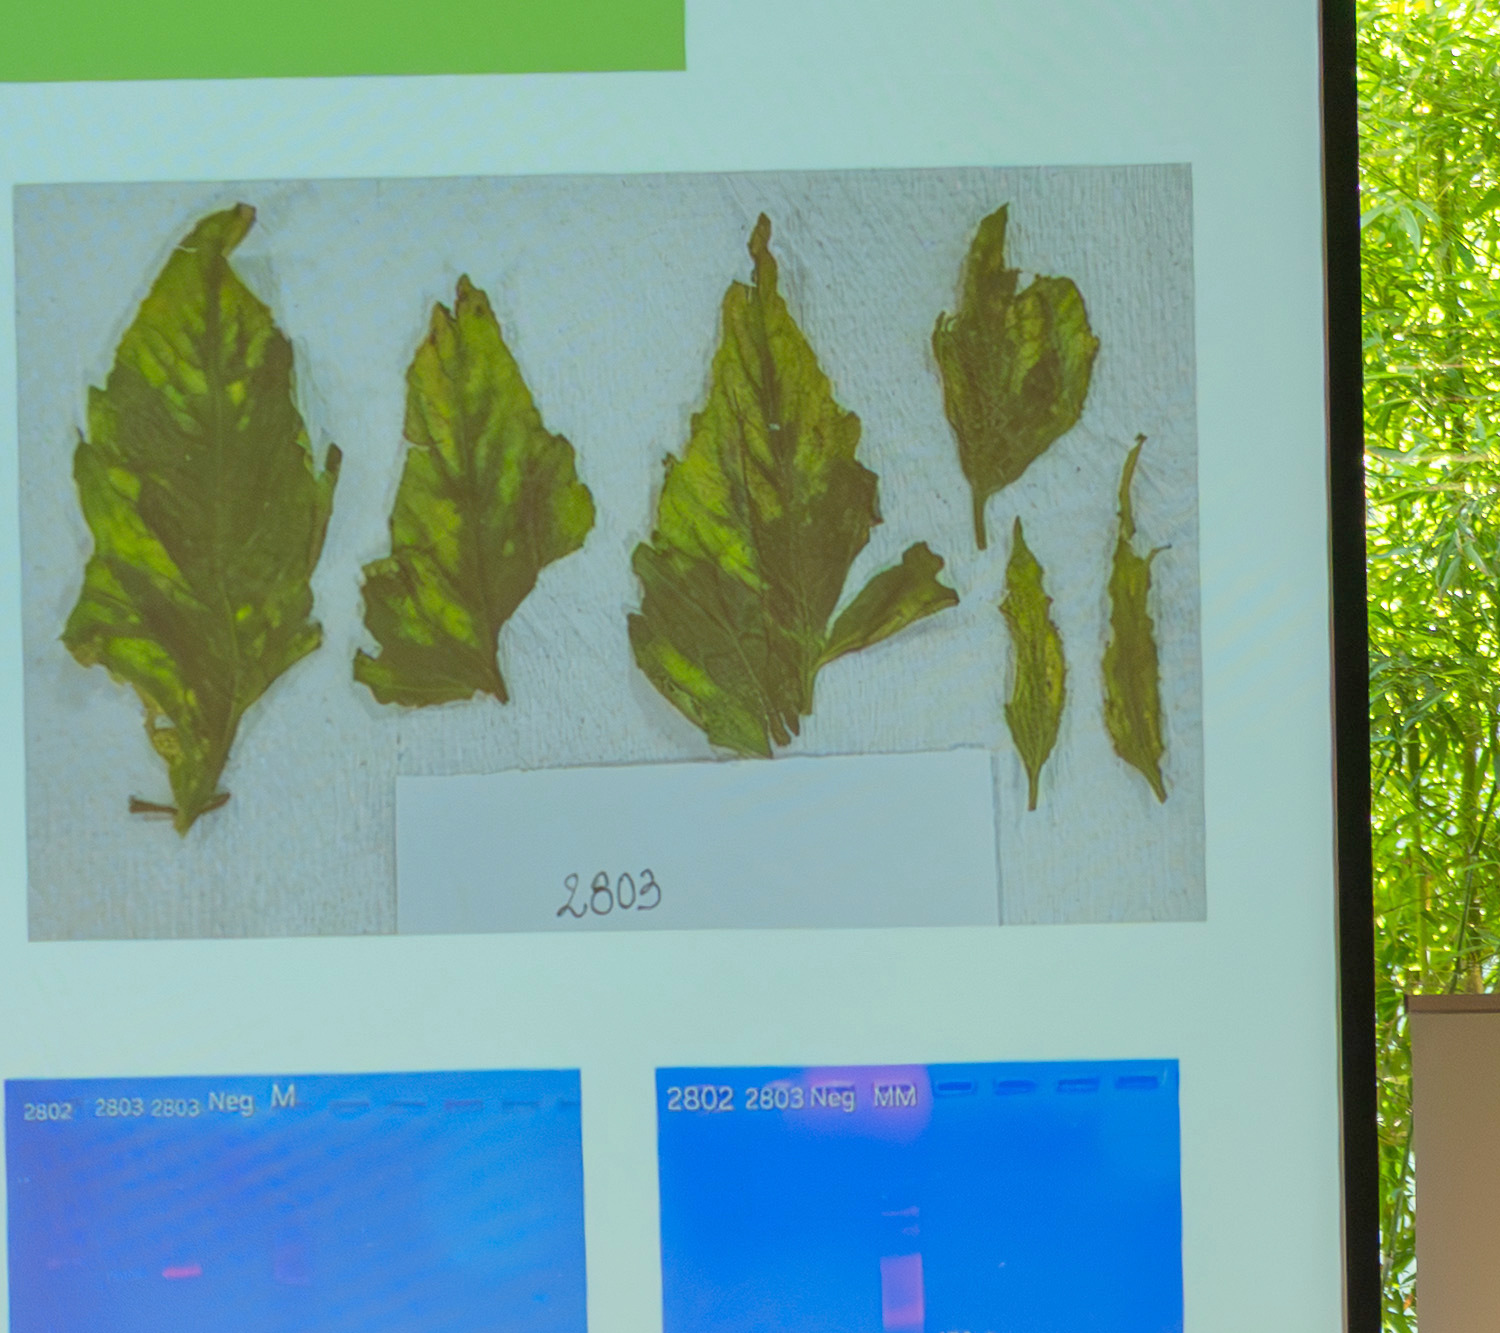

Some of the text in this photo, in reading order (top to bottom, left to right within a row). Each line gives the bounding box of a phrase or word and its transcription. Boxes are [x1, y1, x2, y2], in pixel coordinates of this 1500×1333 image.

[557, 868, 662, 918] 2803
[24, 1101, 73, 1122] 2802
[95, 1097, 145, 1118] 2803
[151, 1098, 200, 1118] 2803
[271, 1083, 297, 1108] M
[666, 1085, 917, 1113] 2802 2803 Neg MM
